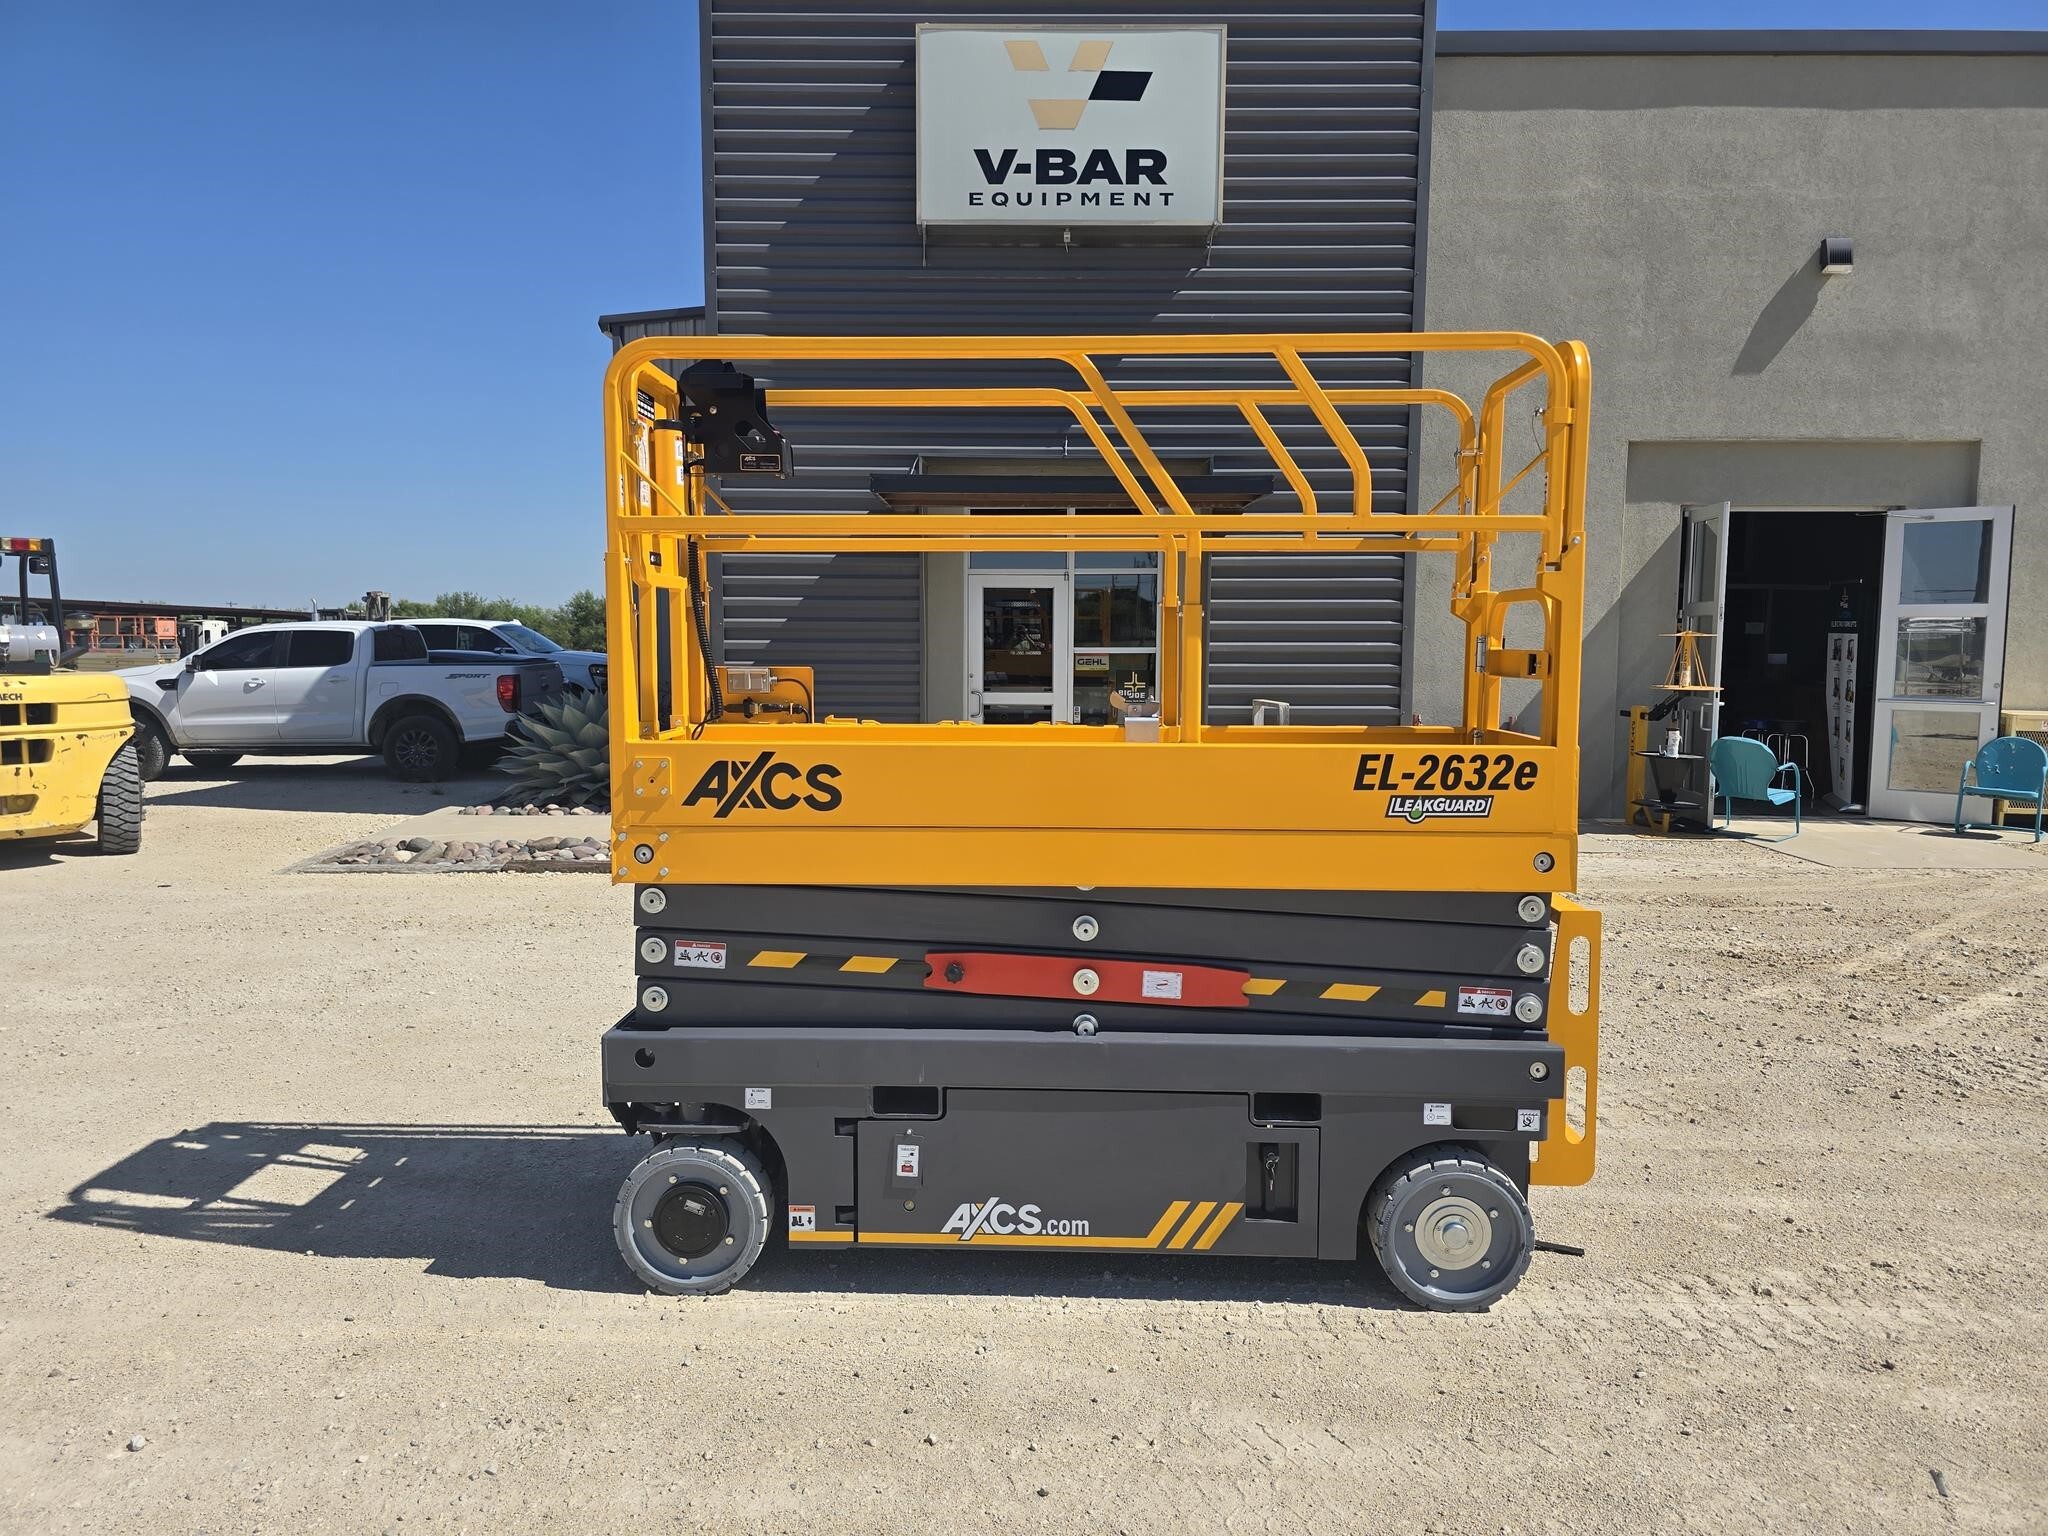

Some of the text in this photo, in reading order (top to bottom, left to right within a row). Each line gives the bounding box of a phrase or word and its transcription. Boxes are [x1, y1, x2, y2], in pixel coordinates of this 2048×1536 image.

[973, 148, 1168, 185] V-BAR
[968, 192, 1174, 207] EQUIPMENT
[1077, 658, 1107, 666] GEHL
[681, 751, 843, 818] AXCS
[1353, 753, 1539, 791] EL-2632e
[940, 1197, 1090, 1241] AXCS.com
